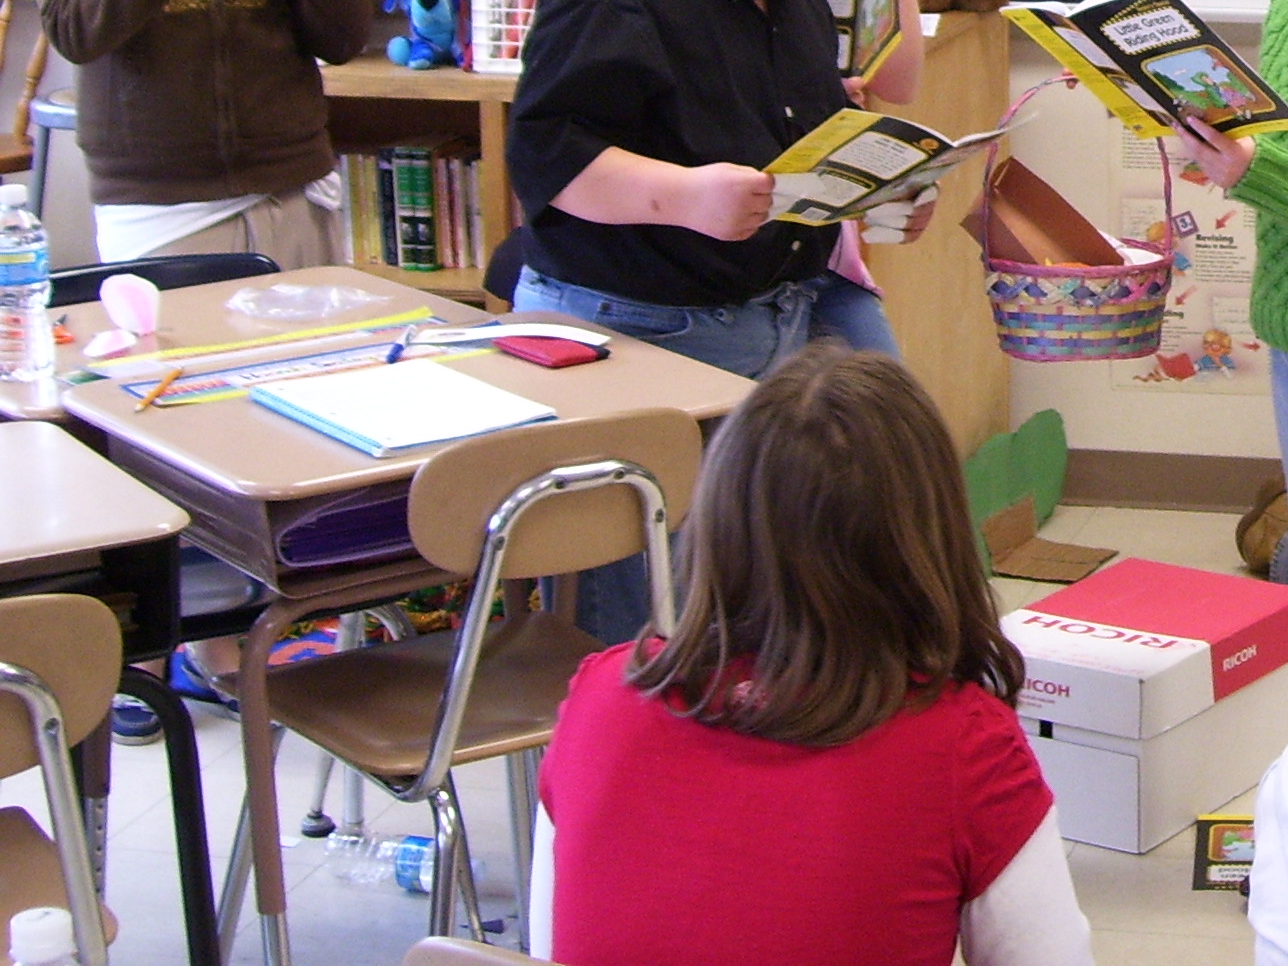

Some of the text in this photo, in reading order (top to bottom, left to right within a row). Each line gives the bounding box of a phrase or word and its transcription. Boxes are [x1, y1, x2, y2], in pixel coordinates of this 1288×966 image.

[1113, 14, 1176, 36] Little Green
[1123, 23, 1189, 47] Riding Hood
[1195, 234, 1234, 244] Revising
[1022, 614, 1178, 649] RICOH
[1222, 645, 1257, 672] RICOH
[1023, 678, 1070, 698] ICOH
